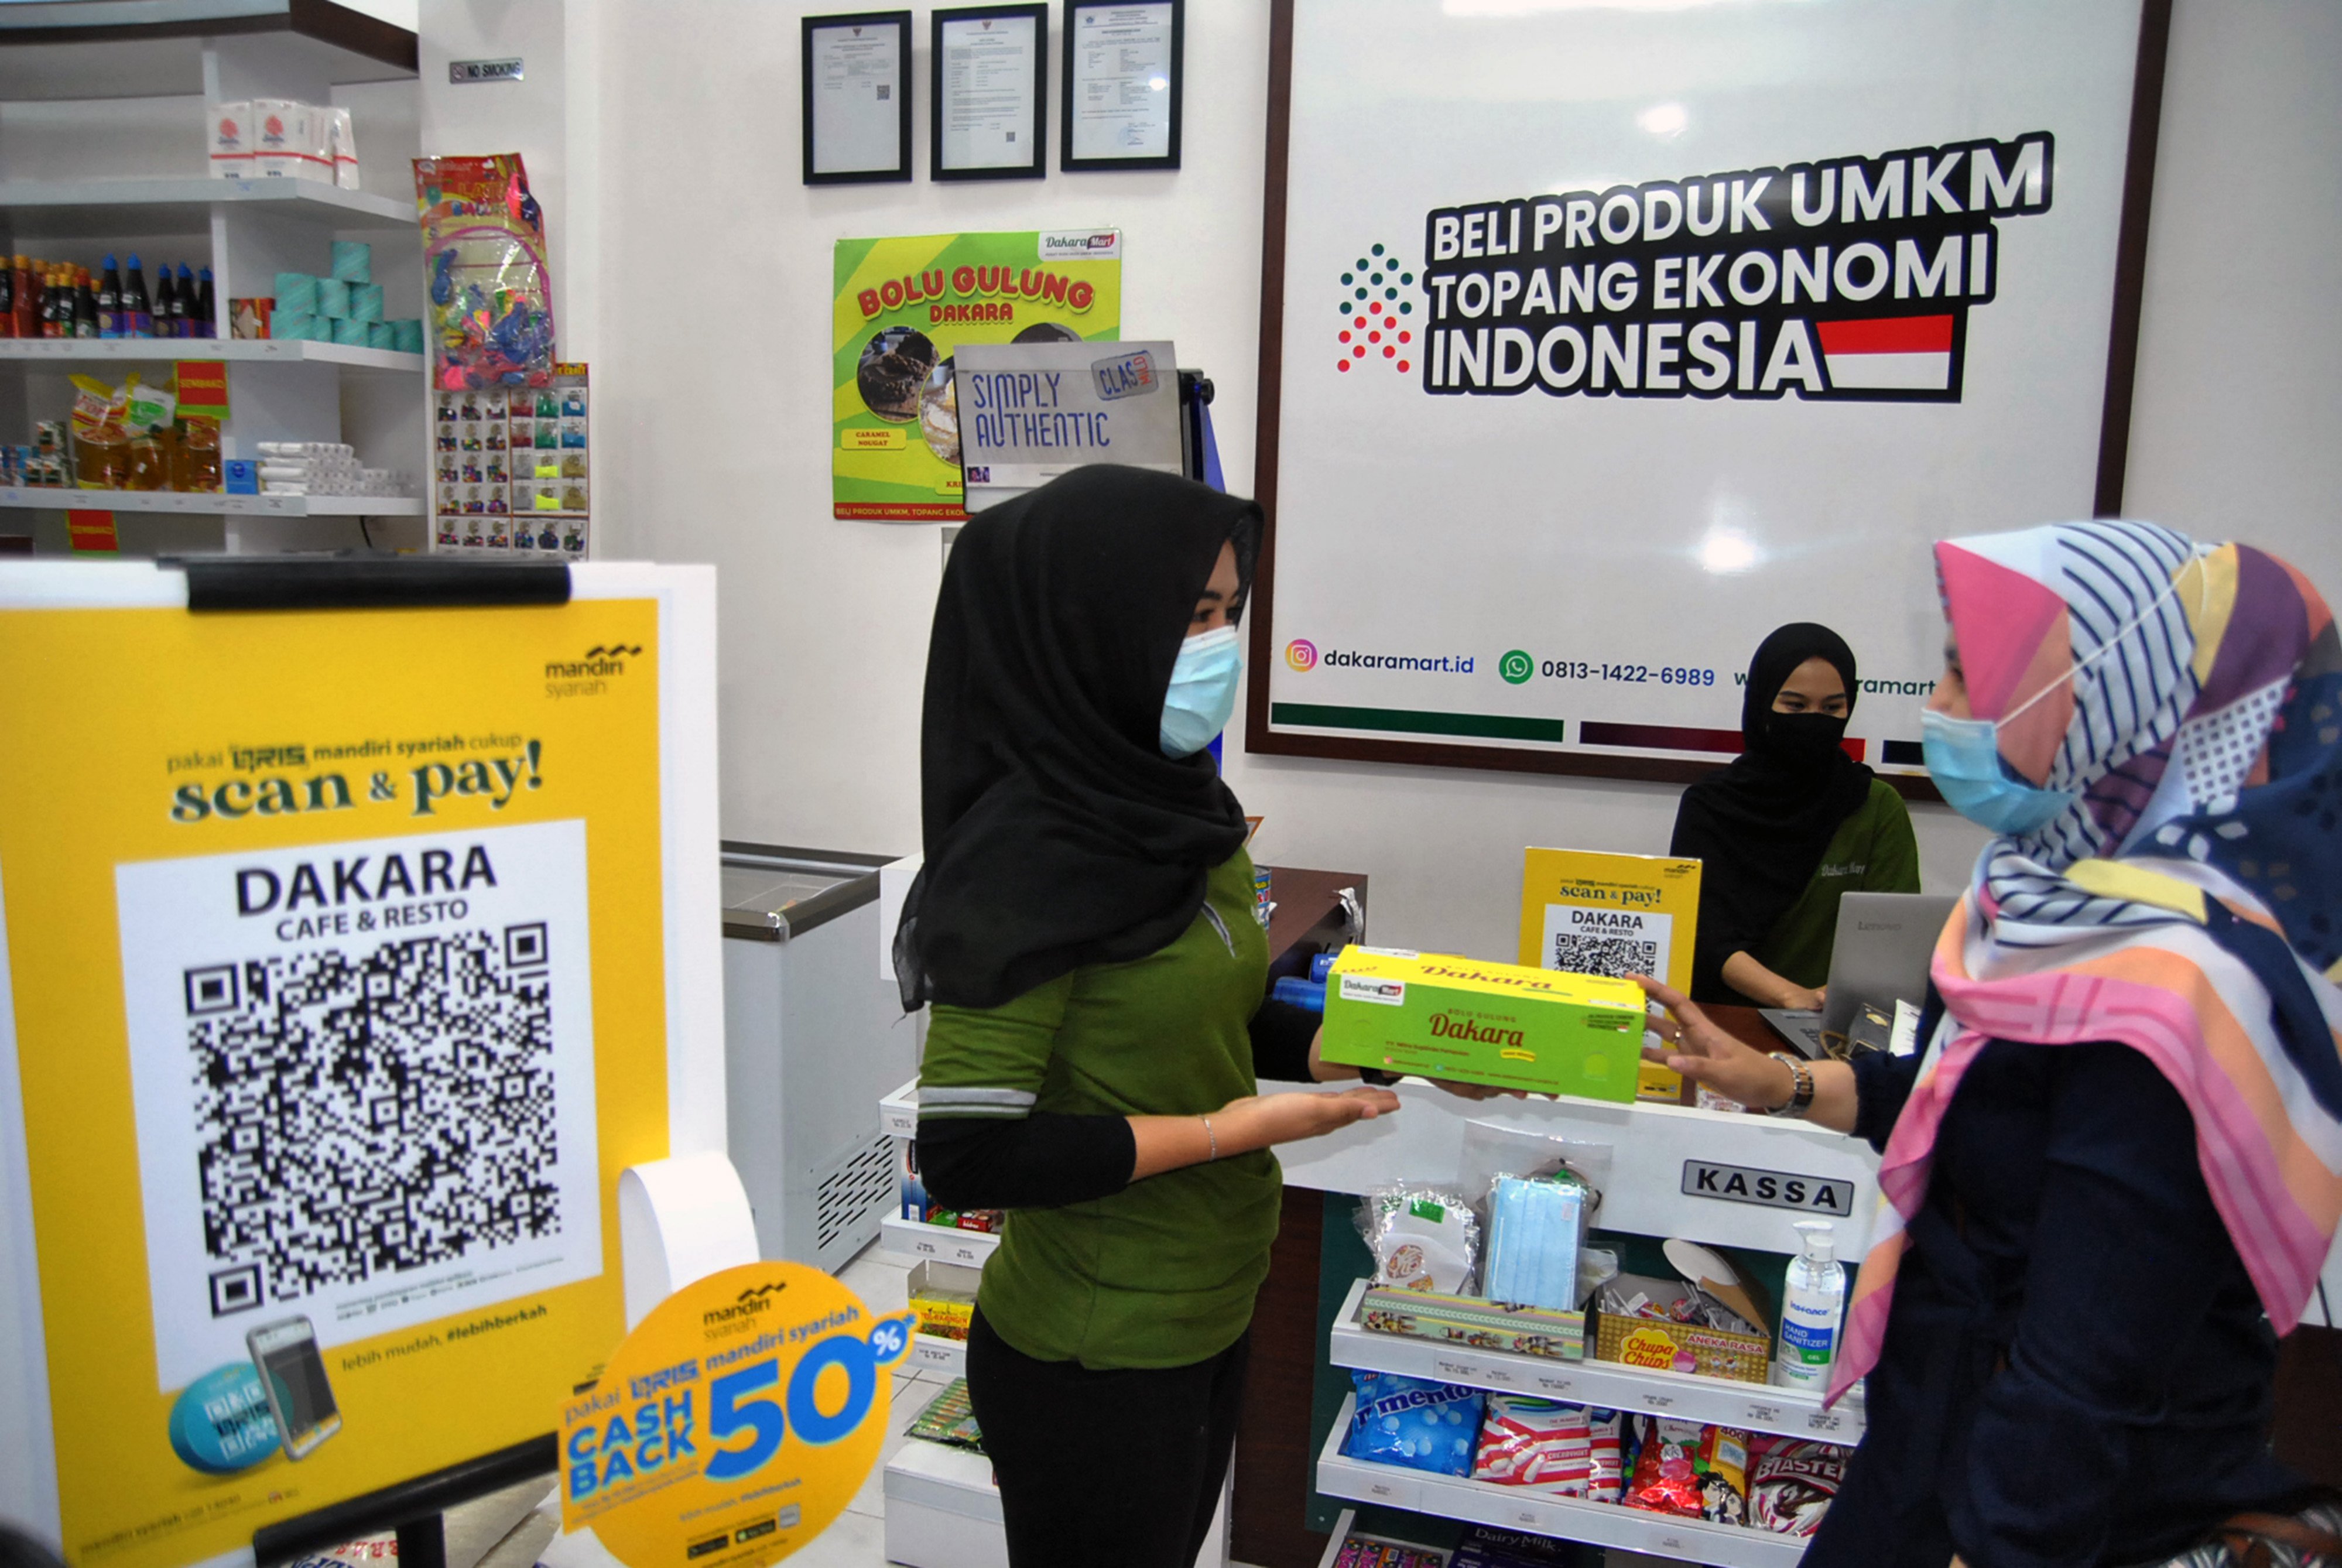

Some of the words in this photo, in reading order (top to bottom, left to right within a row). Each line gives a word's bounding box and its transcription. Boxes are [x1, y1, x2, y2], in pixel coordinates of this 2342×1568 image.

[467, 64, 480, 78] NO
[482, 61, 521, 77] SMOKING
[1434, 211, 1519, 261] BELI
[1534, 177, 1773, 251] PRODUK
[1790, 140, 2044, 228] UMKM
[1046, 237, 1087, 248] Dakara
[1431, 262, 1639, 320] TOPANG
[1654, 232, 1987, 310] EKONOMI
[857, 268, 945, 318] BOLU
[952, 265, 1094, 310] GULUNG
[929, 303, 1014, 323] DAKARA
[1432, 320, 1823, 392] INDONESIA
[972, 372, 1060, 409] SIMPLY
[1100, 361, 1138, 395] CLAS
[975, 412, 1110, 447] AUTHENTIC
[545, 657, 624, 679] mandiri
[1324, 649, 1474, 676] dakaramart.id
[1542, 660, 1715, 687] 0813-1422-6989
[545, 679, 606, 699] syariah
[167, 751, 223, 774] pakai
[313, 738, 392, 761] mandiri
[396, 734, 465, 757] syariah
[470, 732, 522, 754] cukup
[170, 770, 355, 822] scan
[368, 771, 397, 803] &
[409, 739, 543, 817] pay!
[235, 844, 498, 916] DAKARA
[1560, 886, 1606, 899] scan
[1610, 891, 1617, 899] &
[1621, 889, 1661, 907] pay!
[276, 912, 350, 942] CAFE
[357, 909, 376, 933] &
[385, 899, 469, 928] RESTO
[1571, 910, 1643, 929] DAKARA
[1580, 926, 1602, 934] CAFE
[1609, 929, 1634, 937] RESTO
[1858, 922, 1902, 931] Lenovo
[1344, 980, 1379, 992] Dakara
[1420, 965, 1553, 990] Dakara
[1429, 1012, 1524, 1047] Dakara
[1448, 1008, 1474, 1018] BOLU
[1477, 1012, 1517, 1023] GULUNG
[1697, 1168, 1838, 1208] KASSA
[703, 1297, 771, 1325] mandiri
[342, 1349, 382, 1372] lebih
[385, 1335, 443, 1361] mudah,
[446, 1304, 548, 1343] #lebihberkah
[1687, 1334, 1728, 1349] ANEKA
[1730, 1341, 1765, 1354] RASA
[1783, 1331, 1828, 1347] SANITIZER
[1785, 1324, 1808, 1338] HAND
[1624, 1349, 1672, 1370] Chups
[1627, 1336, 1674, 1357] Chupa
[564, 1385, 621, 1427] pakai
[706, 1329, 786, 1371] mandiri
[789, 1305, 860, 1344] syariah
[1376, 1383, 1475, 1415] mento
[568, 1389, 693, 1464] CASH
[569, 1419, 697, 1502] BACK
[1475, 1528, 1520, 1545] Dairy
[1521, 1535, 1556, 1552] Milk
